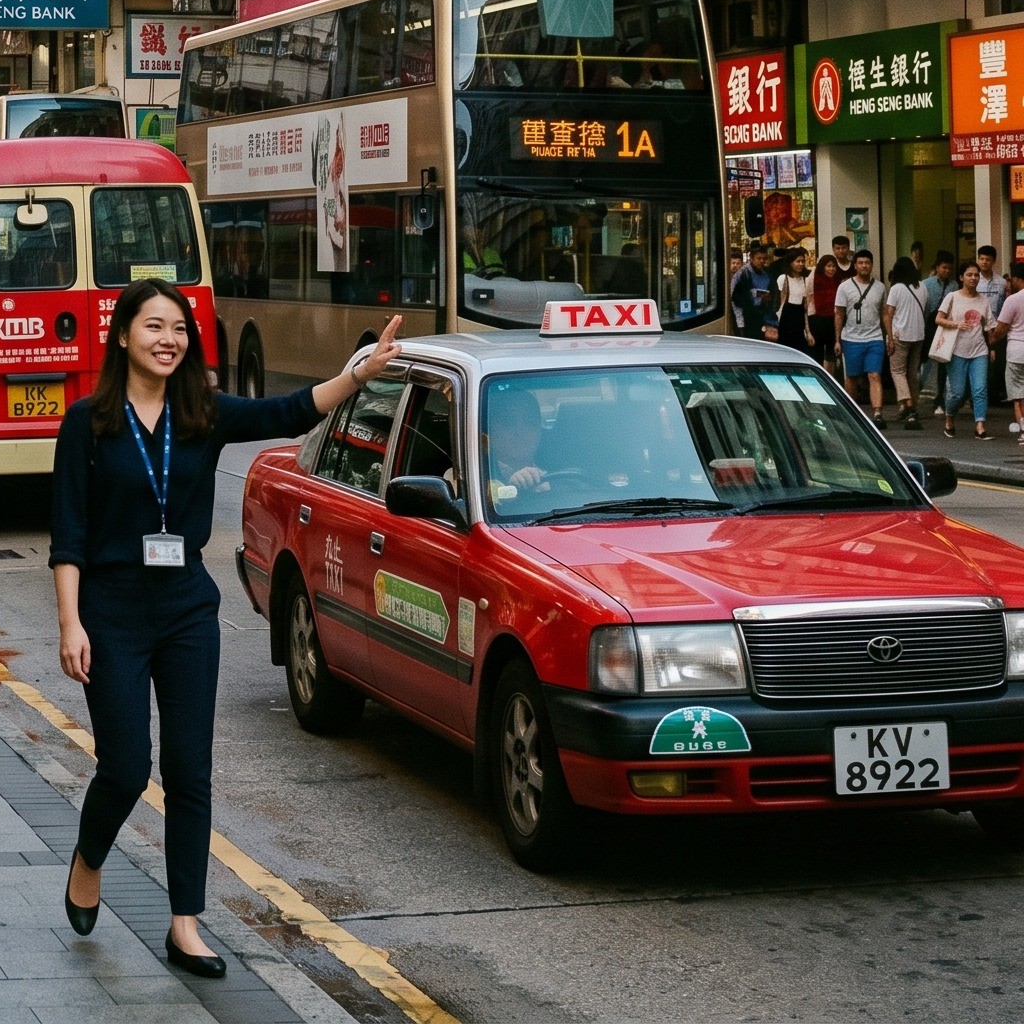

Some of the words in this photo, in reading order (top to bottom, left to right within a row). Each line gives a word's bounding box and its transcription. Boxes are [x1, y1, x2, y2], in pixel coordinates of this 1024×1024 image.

[31, 6, 76, 20] BANK
[727, 60, 781, 116] 銀行
[978, 39, 1009, 124] 豐澤
[904, 92, 933, 110] BANK
[616, 121, 656, 158] 1A
[752, 121, 783, 142] BANK
[560, 304, 651, 328] TAXI
[25, 386, 48, 401] KK
[867, 726, 913, 759] KV
[845, 757, 941, 793] 8922
